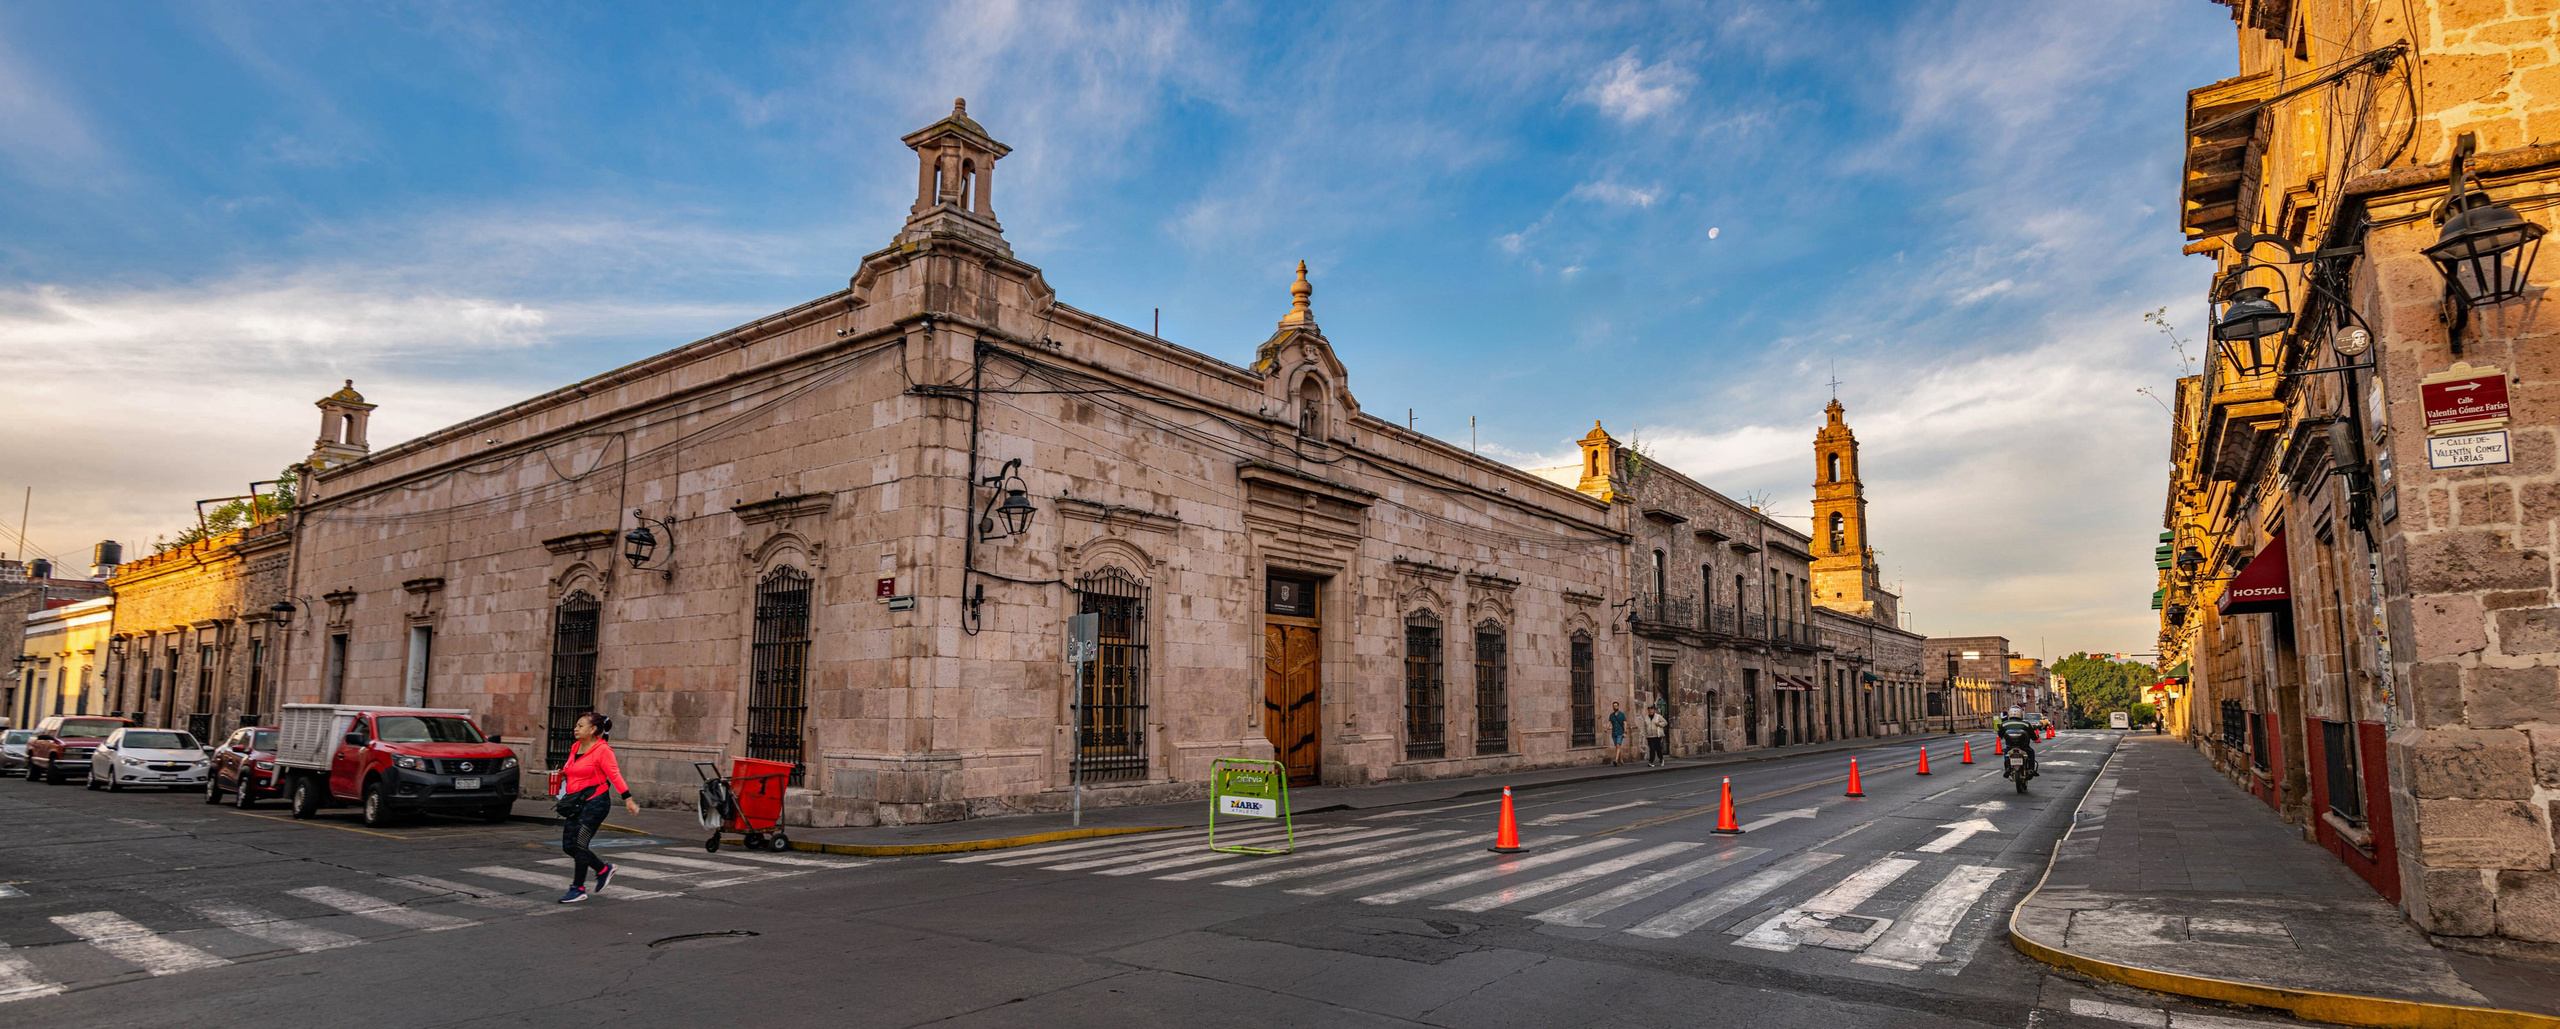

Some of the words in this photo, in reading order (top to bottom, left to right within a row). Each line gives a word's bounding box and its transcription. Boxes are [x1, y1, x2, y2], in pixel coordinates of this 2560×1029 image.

[2457, 397, 2474, 405] Calle
[2427, 408, 2458, 418] Valentín
[2458, 405, 2485, 415] Gómez
[2485, 401, 2509, 411] Farías
[2233, 587, 2286, 597] HOSTAL
